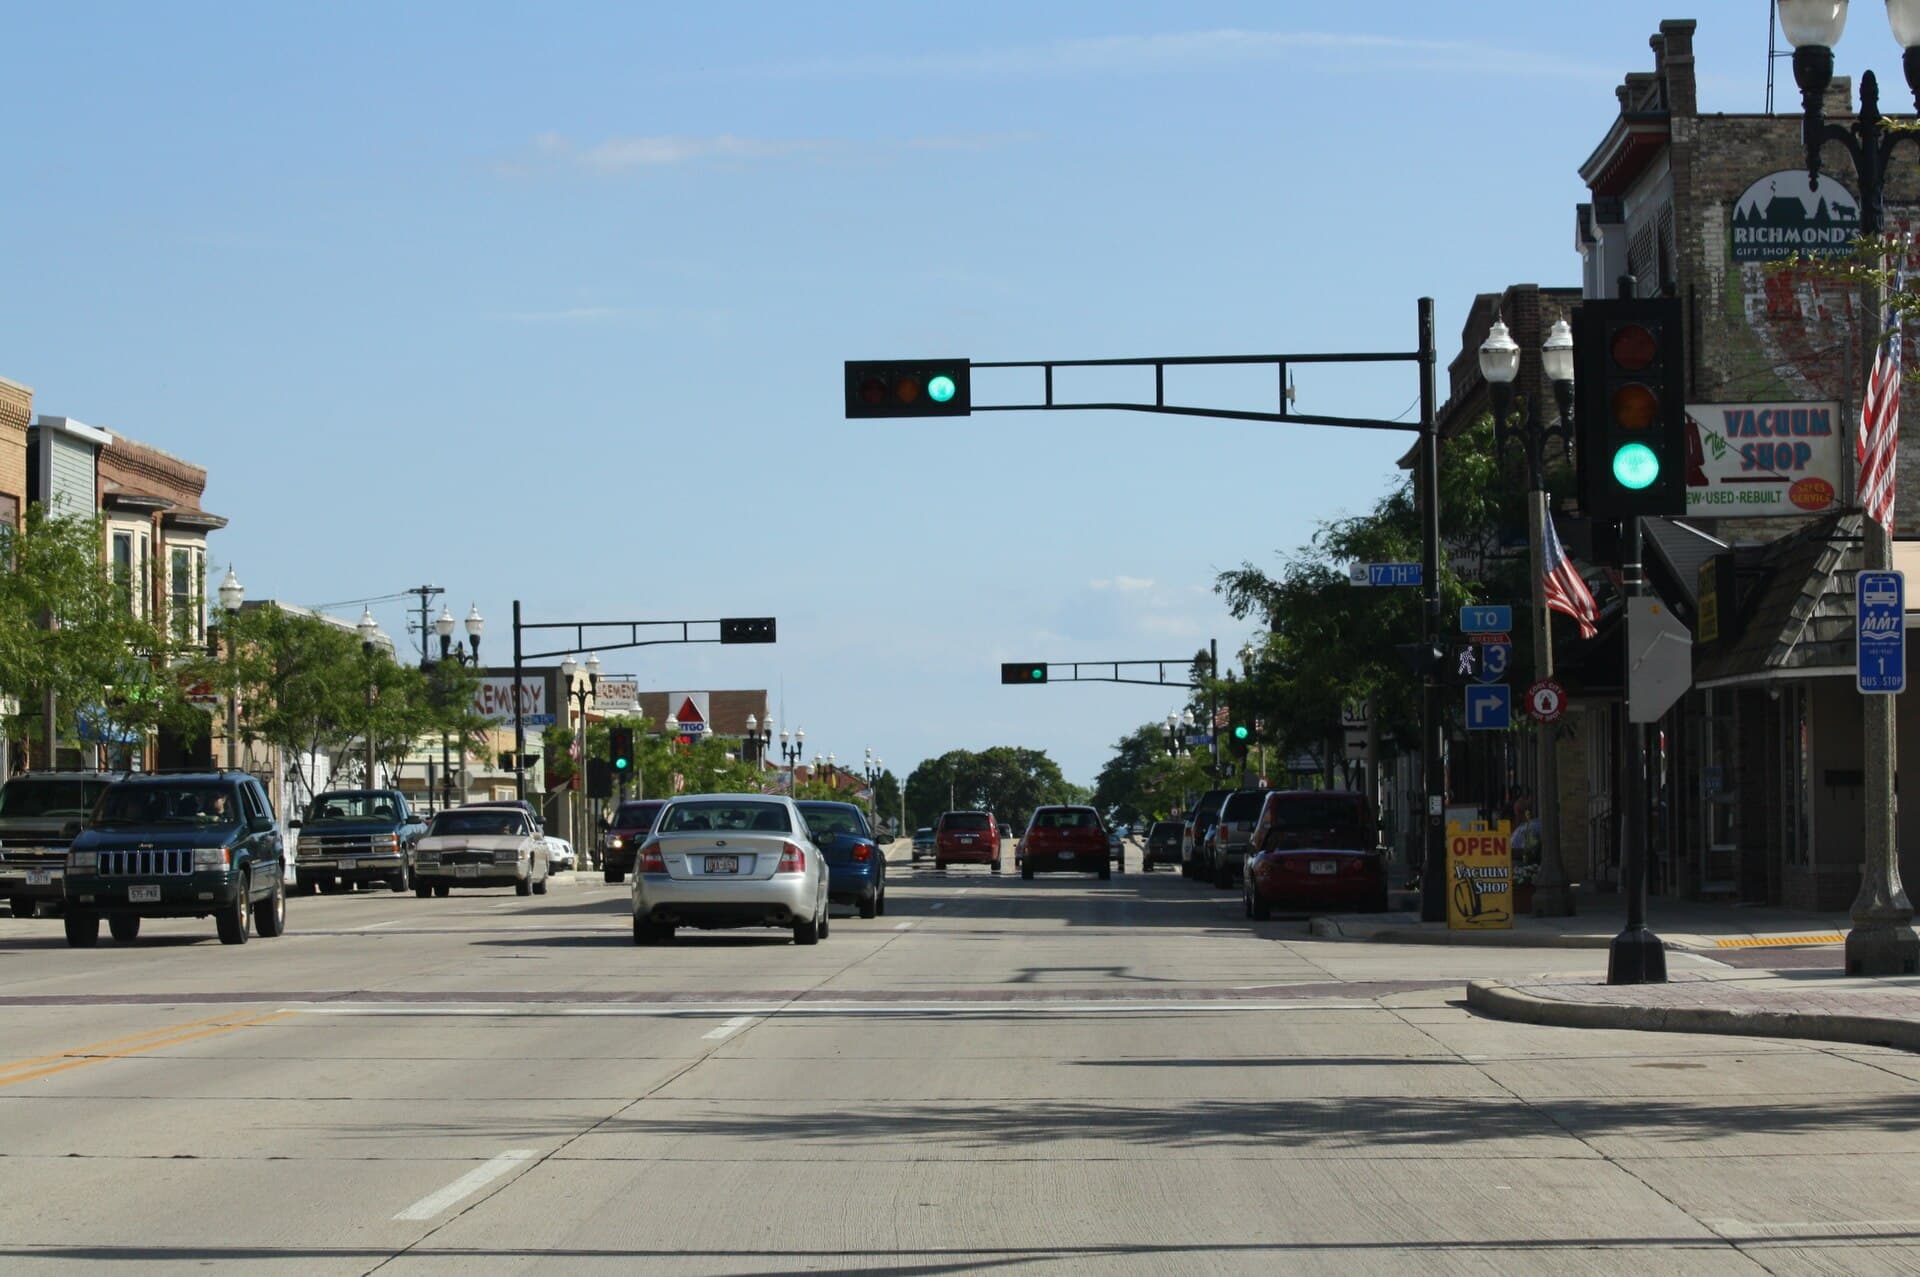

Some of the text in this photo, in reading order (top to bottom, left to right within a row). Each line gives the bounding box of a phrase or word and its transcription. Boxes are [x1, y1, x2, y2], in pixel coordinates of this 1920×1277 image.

[1734, 227, 1861, 243] RICHMOND'S
[1736, 247, 1757, 256] GIFT
[1763, 247, 1789, 256] SHOP
[1723, 408, 1832, 438] VACUUM
[1741, 441, 1812, 471] SHOP
[1371, 566, 1385, 583] 17
[1391, 566, 1407, 583] TH
[1474, 611, 1498, 626] TO
[1862, 615, 1900, 630] MMT
[1878, 657, 1885, 676] 1
[1861, 676, 1902, 687] BUS STOP
[1453, 837, 1507, 856] OPEN
[1455, 865, 1508, 879] VACUUM
[1475, 881, 1508, 895] SHOP
